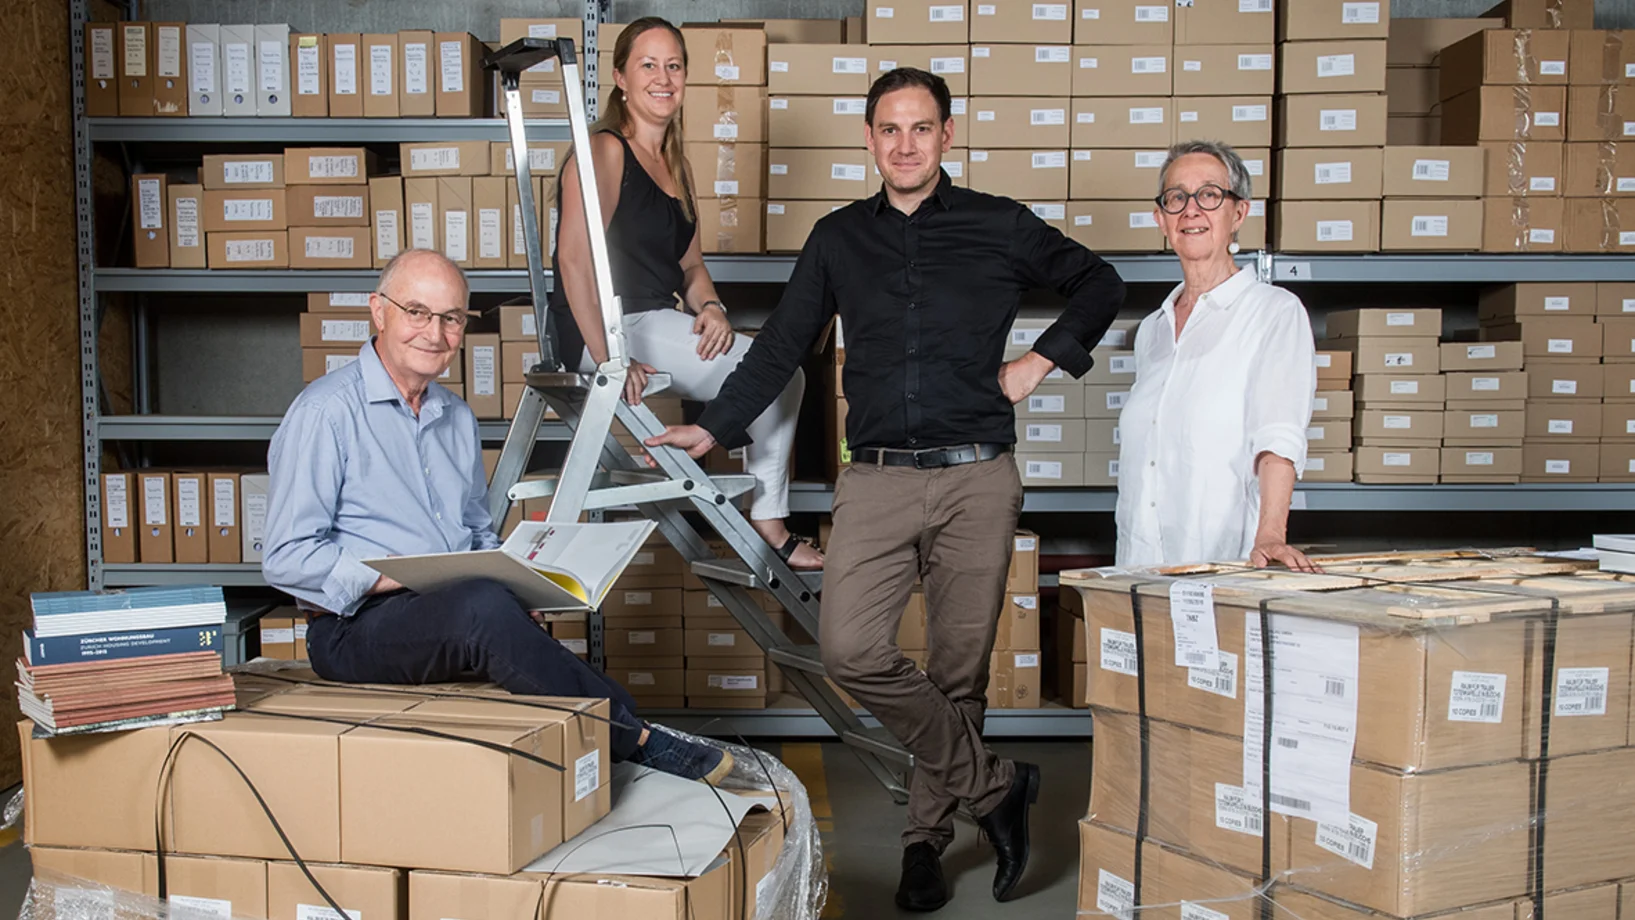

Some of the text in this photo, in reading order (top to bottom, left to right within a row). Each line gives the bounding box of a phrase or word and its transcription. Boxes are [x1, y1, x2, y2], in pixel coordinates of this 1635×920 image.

[1289, 265, 1298, 276] 4
[108, 633, 154, 642] WOHNUNGSBAU
[131, 638, 171, 647] DEVELOPMENT
[1564, 703, 1581, 711] COPIES
[1458, 708, 1477, 717] COPIES
[1326, 837, 1345, 851] COPIES
